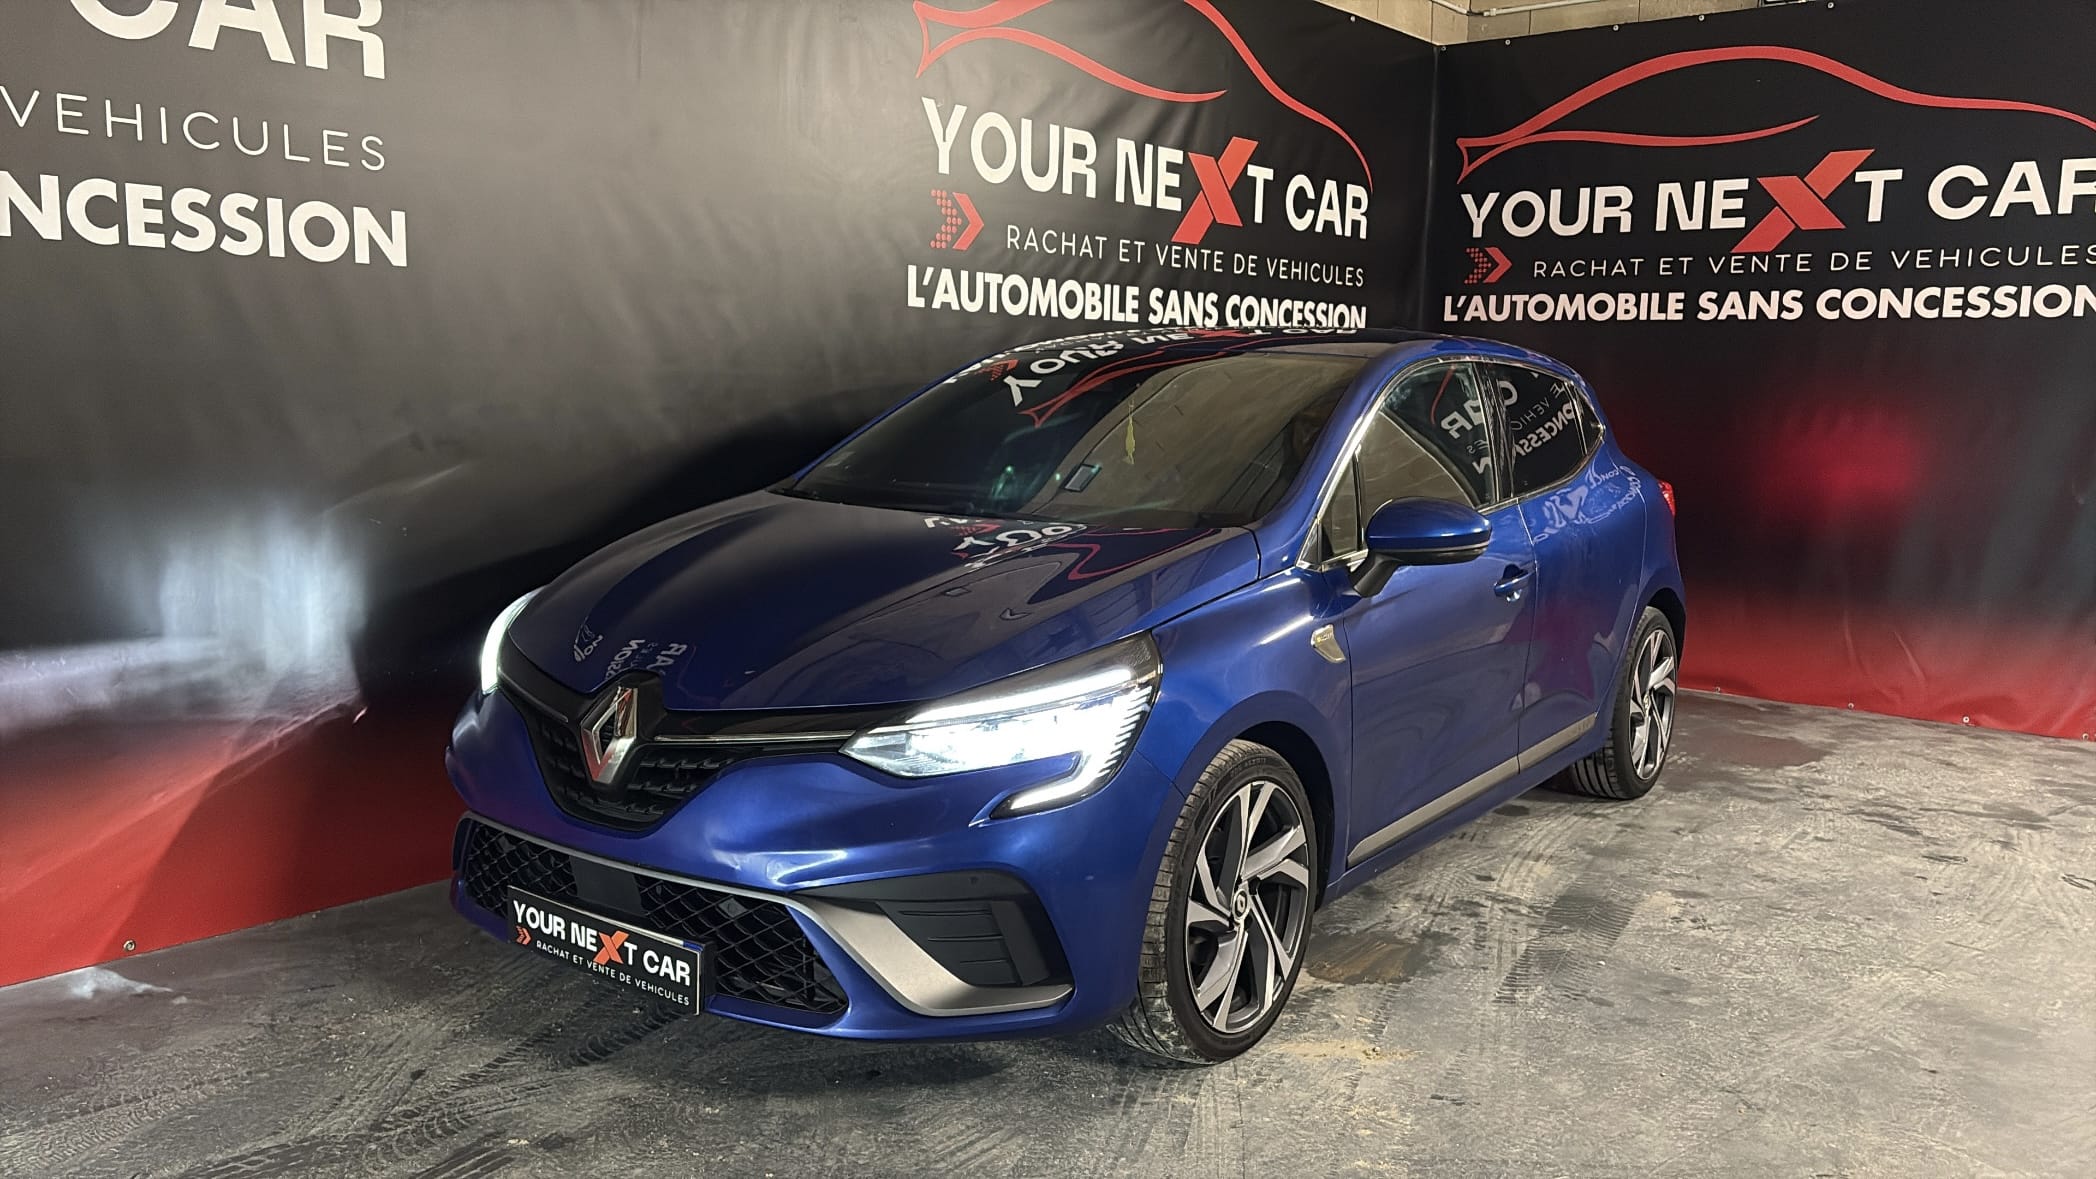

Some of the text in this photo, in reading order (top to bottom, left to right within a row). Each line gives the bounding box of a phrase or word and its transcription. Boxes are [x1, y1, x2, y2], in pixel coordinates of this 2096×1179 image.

[0, 85, 386, 171] VEHICULES
[921, 96, 1369, 246] YOUR NEXT CAR
[1460, 149, 2096, 254] YOUR NEXT CAR
[1007, 224, 1365, 288] RACHAT ET VENTE DE VEHICULES
[1533, 258, 1645, 279] RACHAT
[1659, 256, 1694, 276] ET
[1708, 253, 1813, 274] VENTE
[1830, 250, 1873, 271] DE
[1147, 287, 1219, 328] SANS
[1225, 294, 1367, 329] CONCESSION
[1696, 289, 1804, 321] SANS
[513, 899, 691, 987] YOUR NEXT CAR
[536, 940, 690, 1007] RACHAT ET VENTE DE VEHICULES
